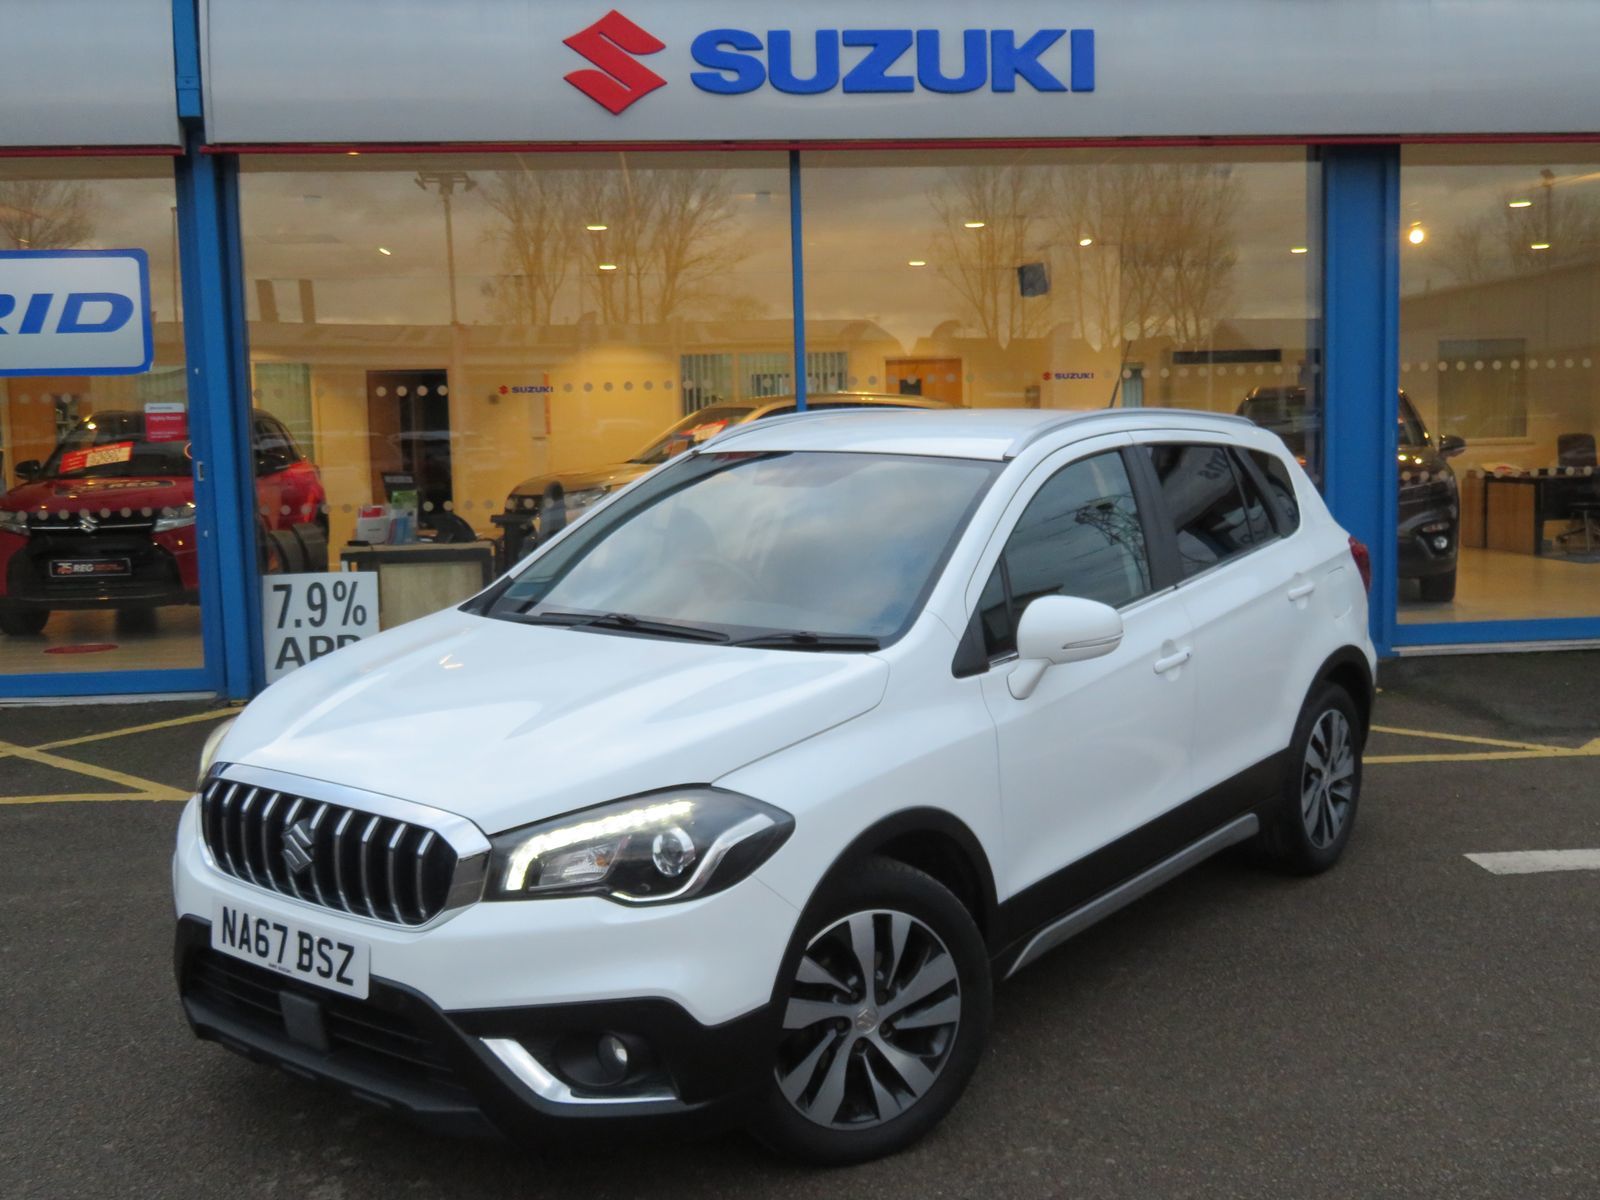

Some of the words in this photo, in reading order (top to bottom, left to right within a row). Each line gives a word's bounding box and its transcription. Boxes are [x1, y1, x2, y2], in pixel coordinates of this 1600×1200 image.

[690, 28, 1094, 95] SUZUKI
[0, 292, 134, 335] ID
[511, 386, 554, 394] SUZUKI
[1055, 372, 1095, 380] SUZUKI
[73, 563, 95, 573] REG
[272, 580, 367, 629] 7.9%
[222, 906, 288, 964] NA67
[297, 930, 355, 987] BSZ
